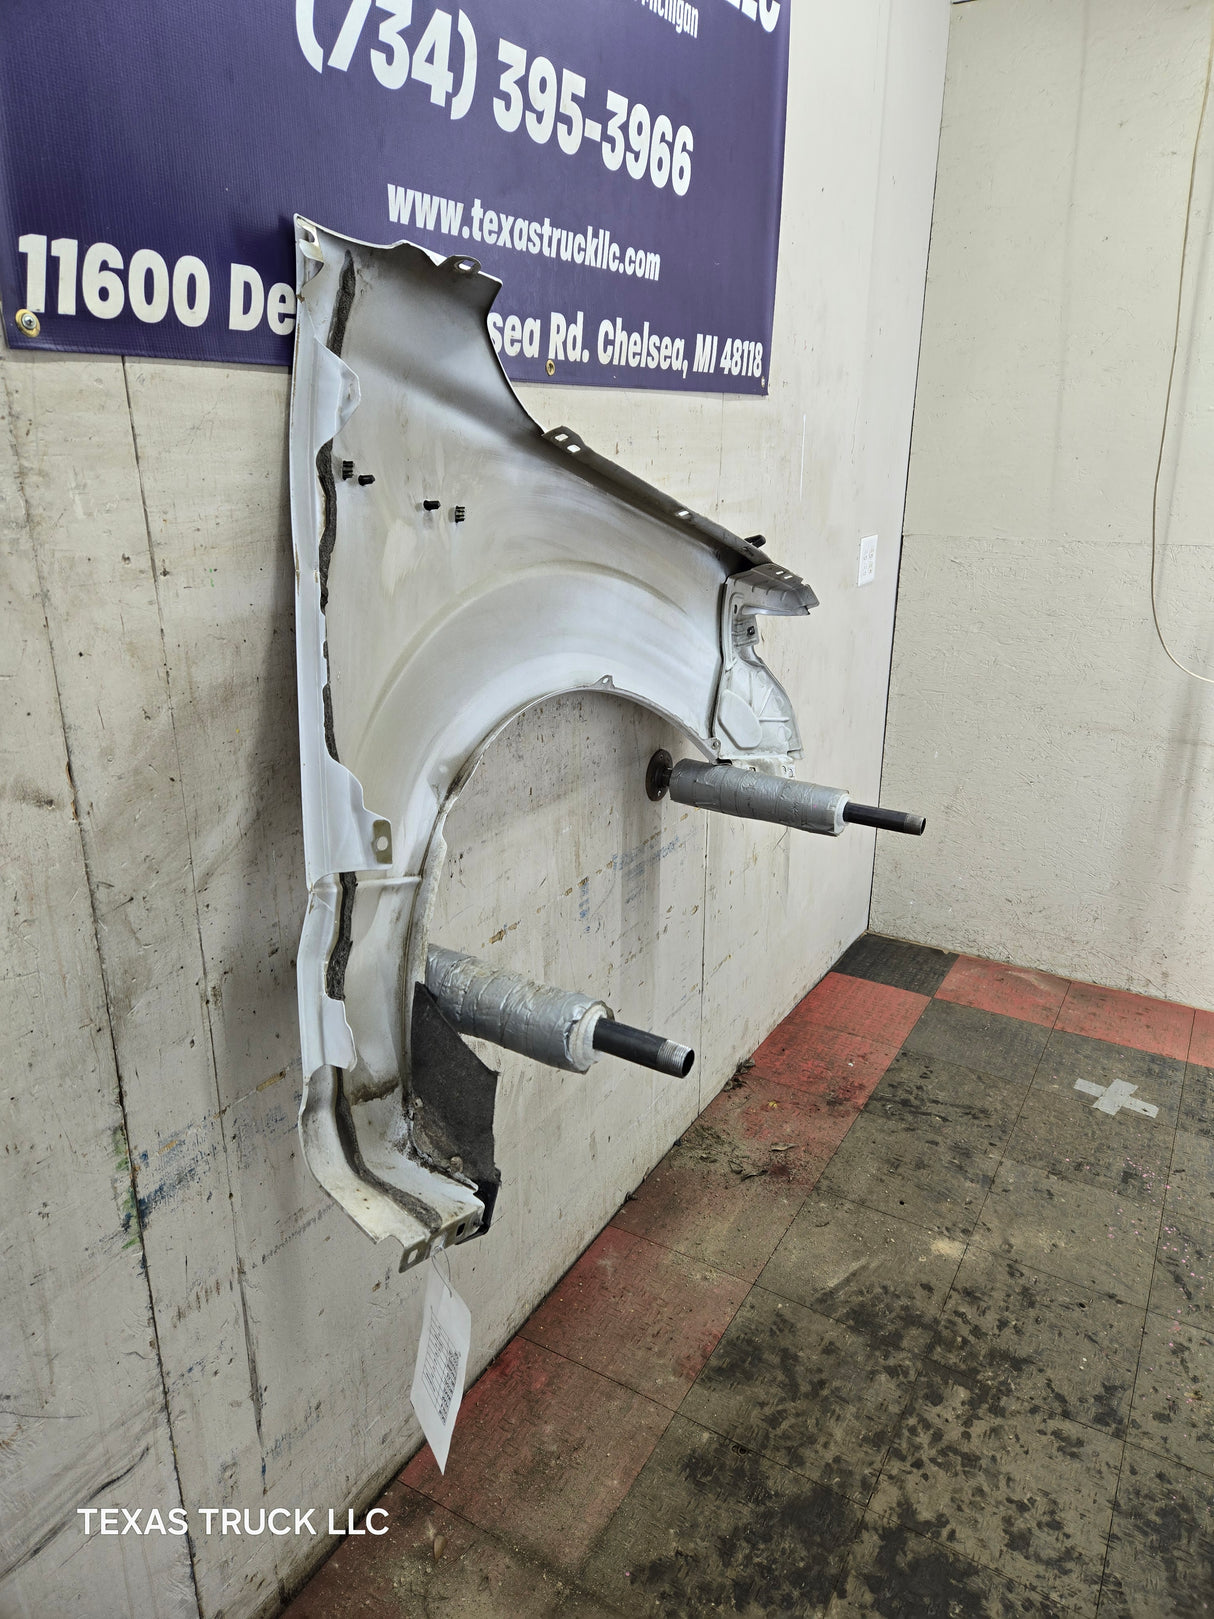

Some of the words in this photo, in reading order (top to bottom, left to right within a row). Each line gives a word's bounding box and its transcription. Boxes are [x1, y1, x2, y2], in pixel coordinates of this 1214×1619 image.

[493, 38, 693, 197] 395-3966
[387, 183, 662, 282] www.texastruckllc.com
[18, 233, 211, 331] 11600
[548, 311, 590, 363] Rd.
[597, 316, 688, 379] Chelsea,
[693, 333, 719, 374] MI
[719, 337, 763, 378] 48118
